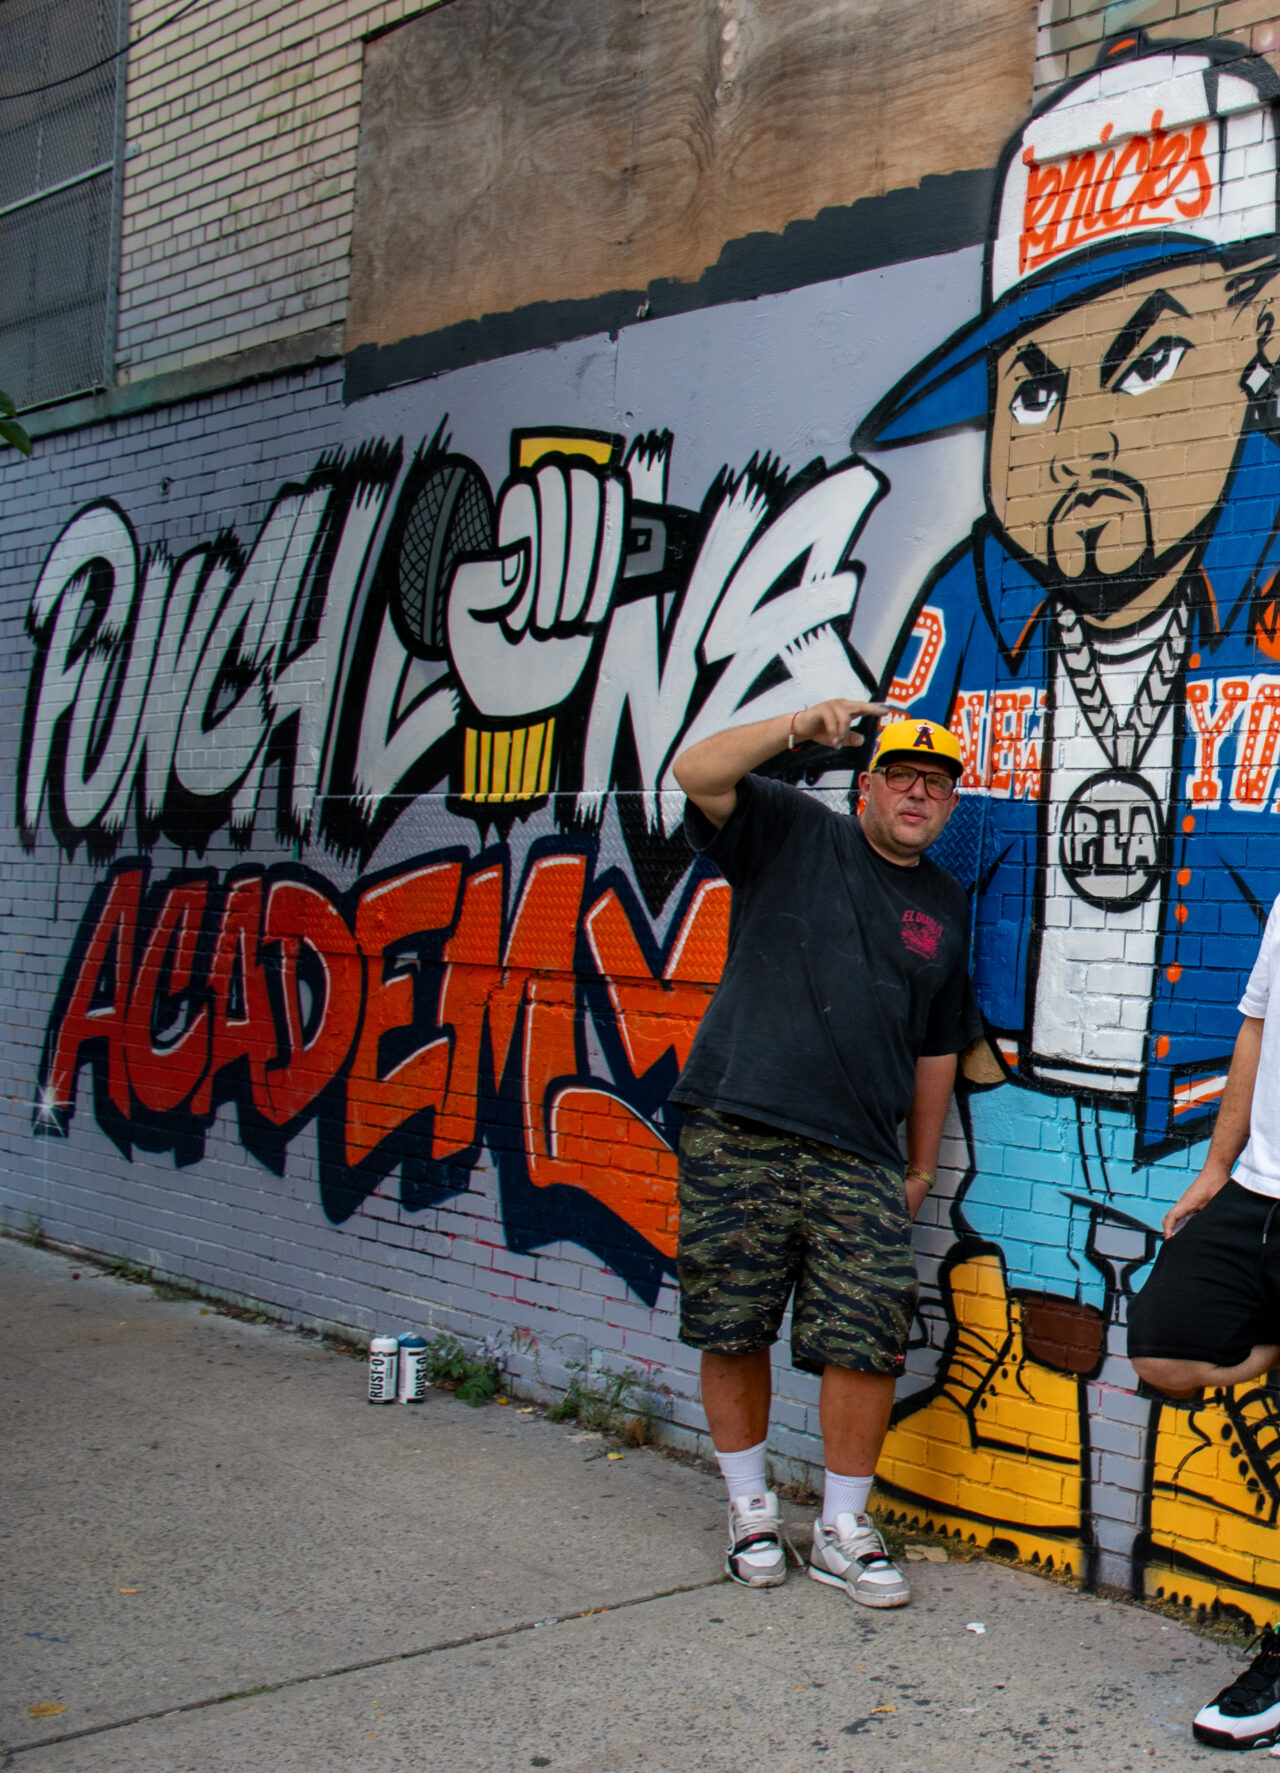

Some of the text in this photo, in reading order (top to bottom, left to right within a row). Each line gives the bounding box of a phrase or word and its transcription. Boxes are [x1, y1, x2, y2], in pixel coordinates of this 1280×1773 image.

[912, 723, 935, 750] A
[1069, 805, 1160, 873] PLA
[33, 846, 730, 1300] ACADEMY
